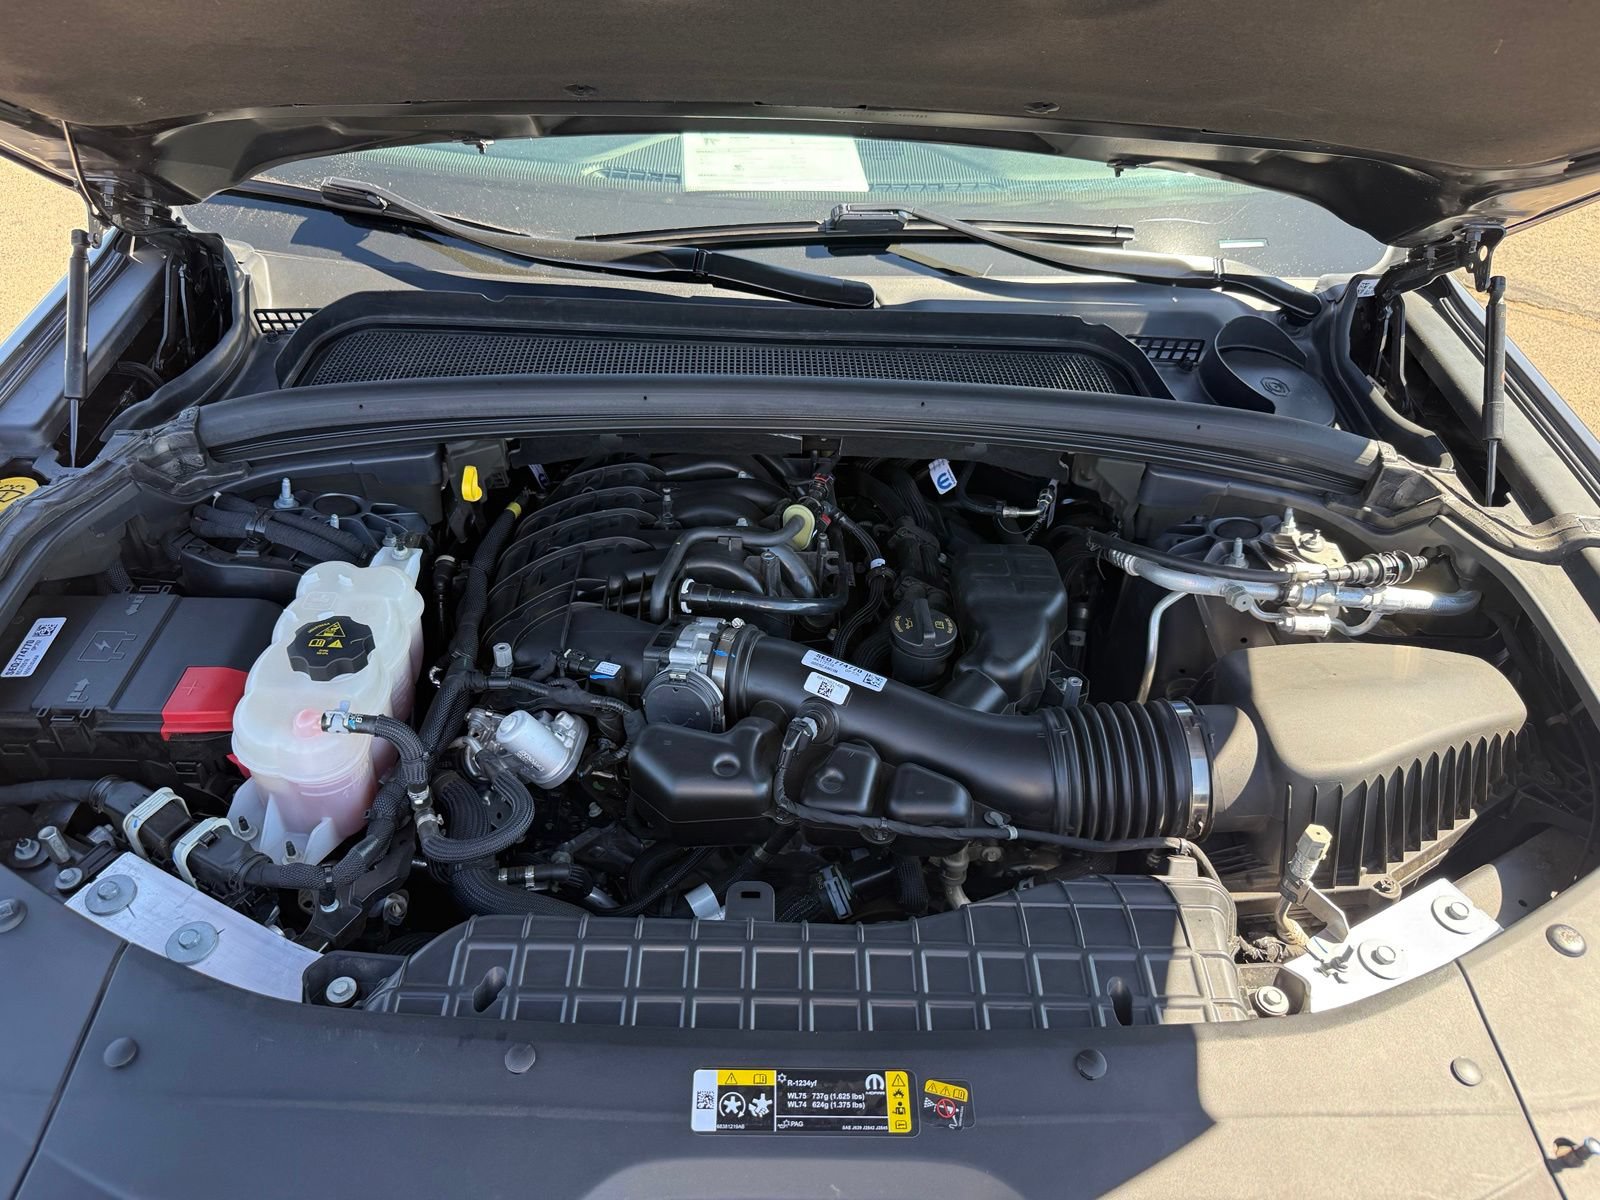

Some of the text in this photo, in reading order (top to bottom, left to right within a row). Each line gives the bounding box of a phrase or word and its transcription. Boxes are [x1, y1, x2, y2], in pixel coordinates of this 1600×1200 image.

[787, 1079, 818, 1089] R-1234yf
[787, 1092, 866, 1101] WL75 737g (1.625 lbs)
[787, 1101, 866, 1110] WL74 624g (1.375 lbs)
[791, 1120, 804, 1128] PAG
